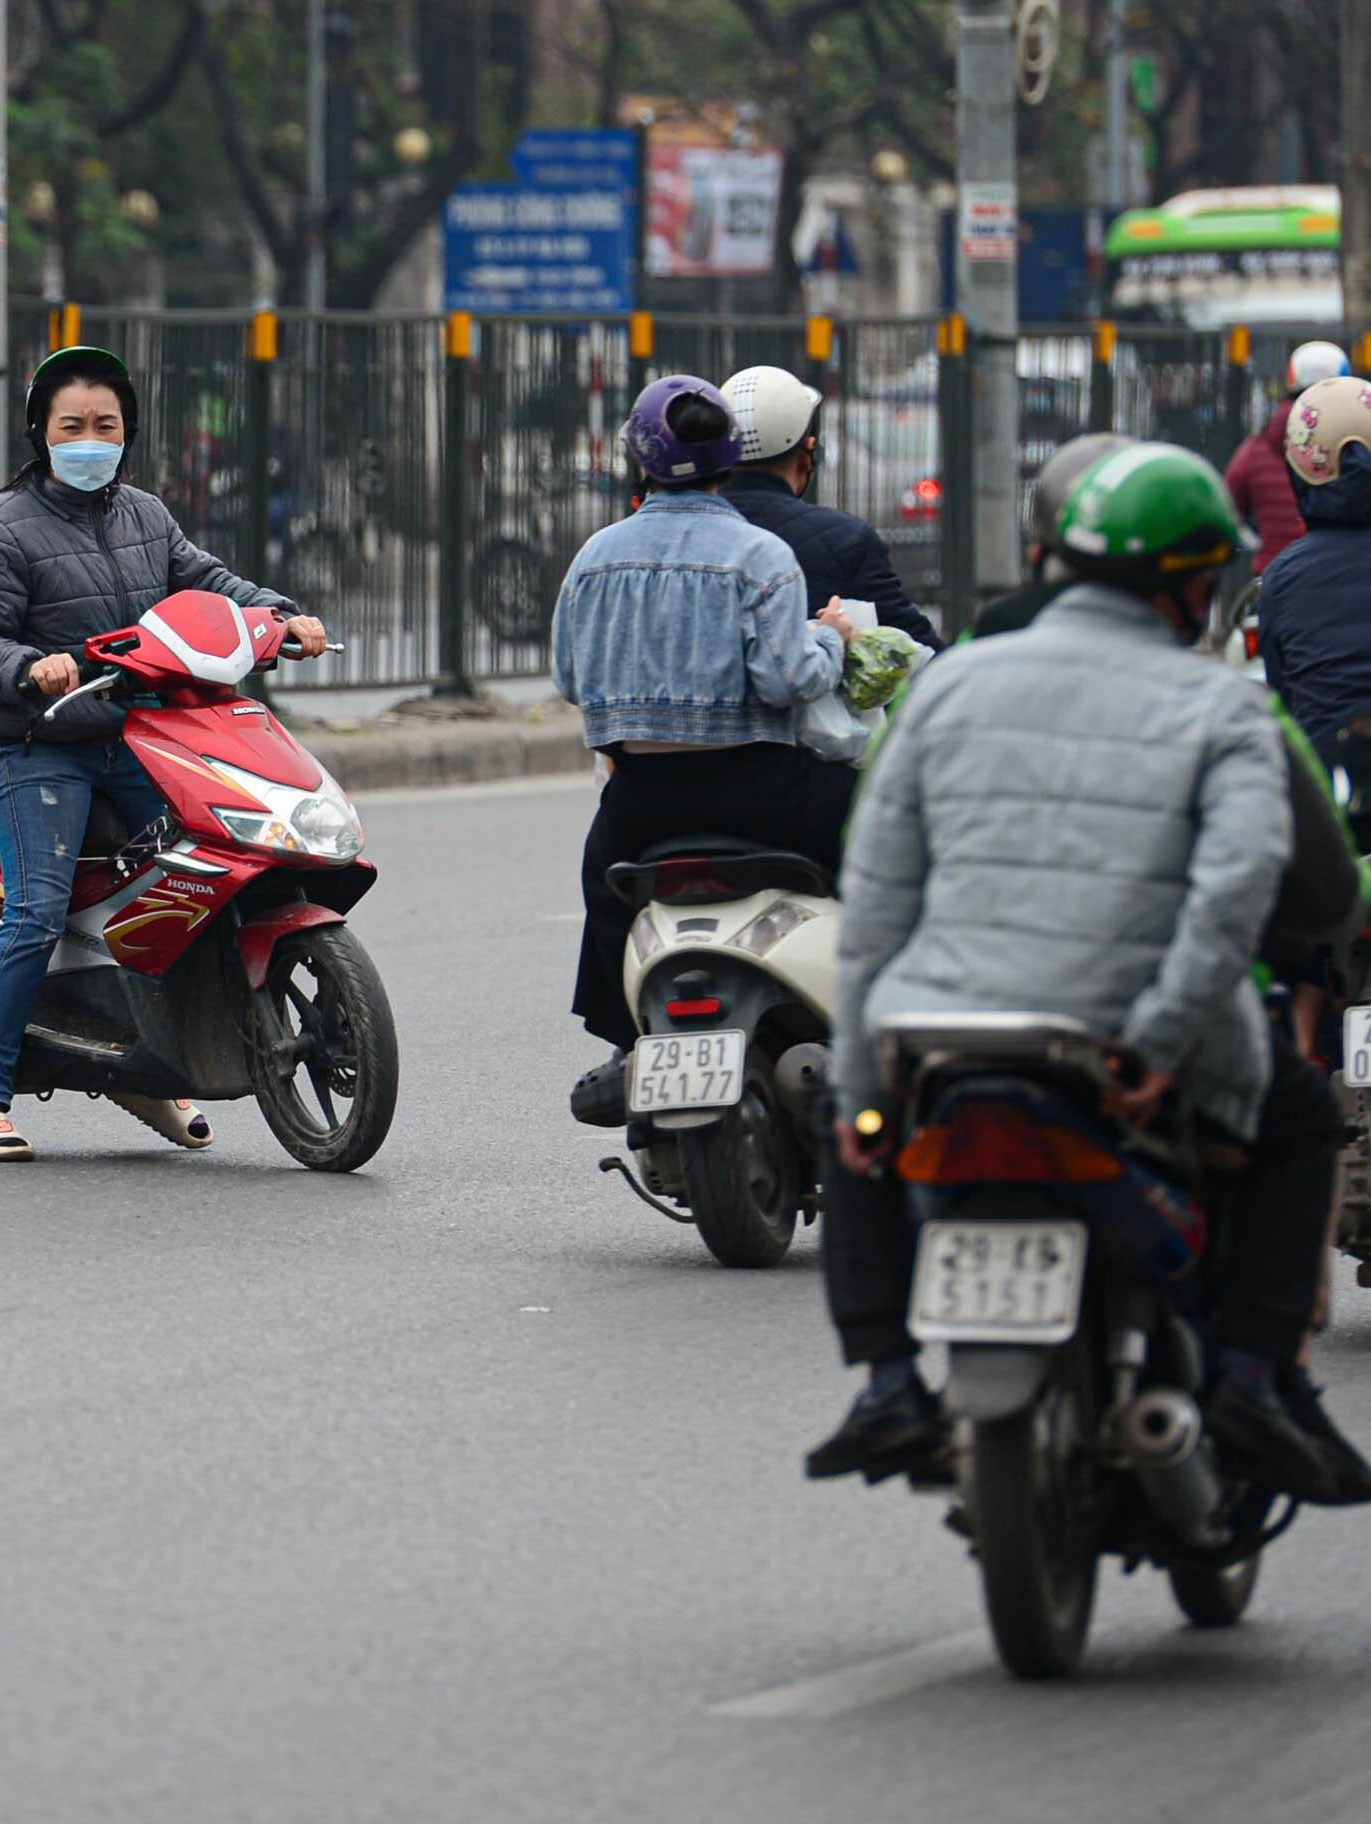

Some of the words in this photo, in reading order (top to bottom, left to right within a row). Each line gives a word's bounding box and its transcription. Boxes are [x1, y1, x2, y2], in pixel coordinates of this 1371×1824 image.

[167, 878, 215, 895] HONDA
[651, 1038, 725, 1071] 29-B1
[640, 1070, 733, 1104] 541.77
